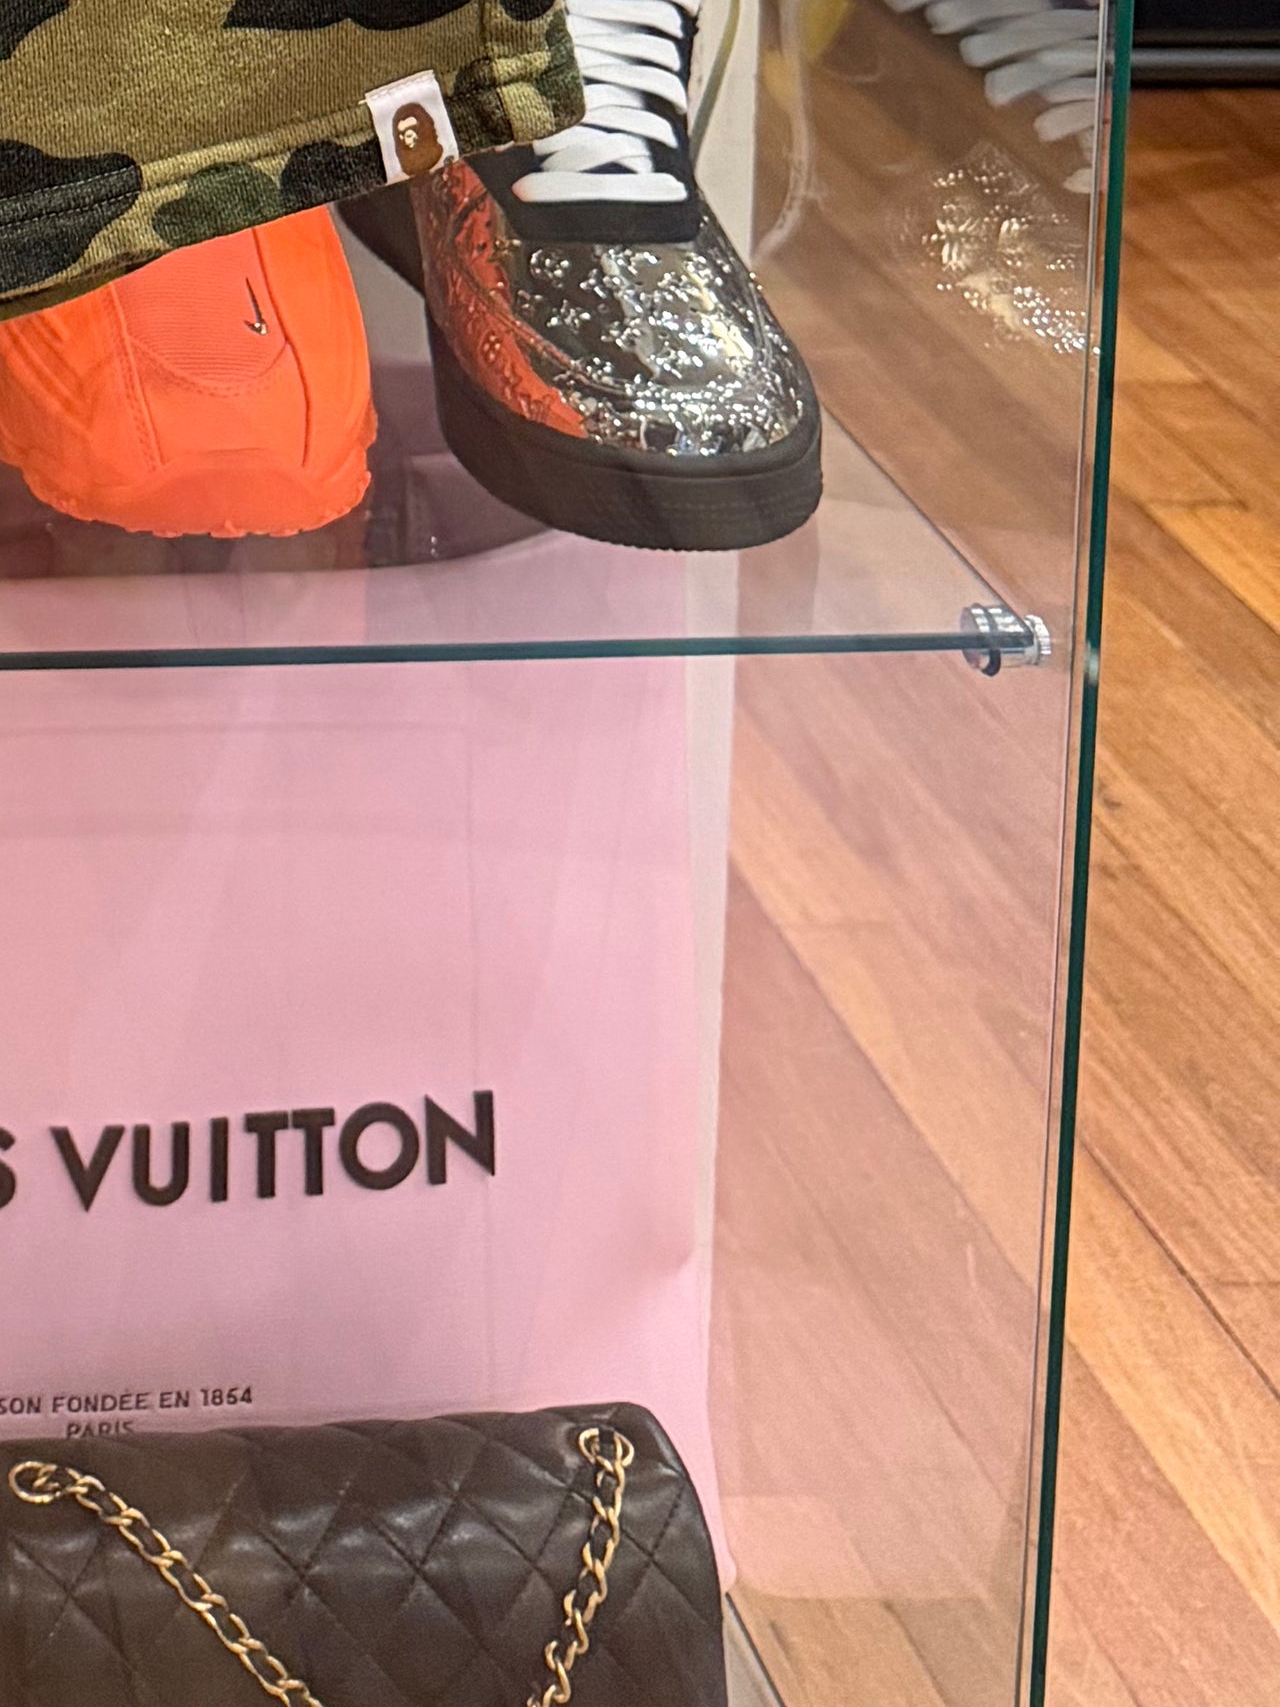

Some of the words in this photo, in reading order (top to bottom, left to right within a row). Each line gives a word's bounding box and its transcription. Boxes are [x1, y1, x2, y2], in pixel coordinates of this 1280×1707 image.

[51, 1089, 496, 1212] VUITTON
[158, 1390, 191, 1408] EN
[65, 1419, 135, 1440] PARIS
